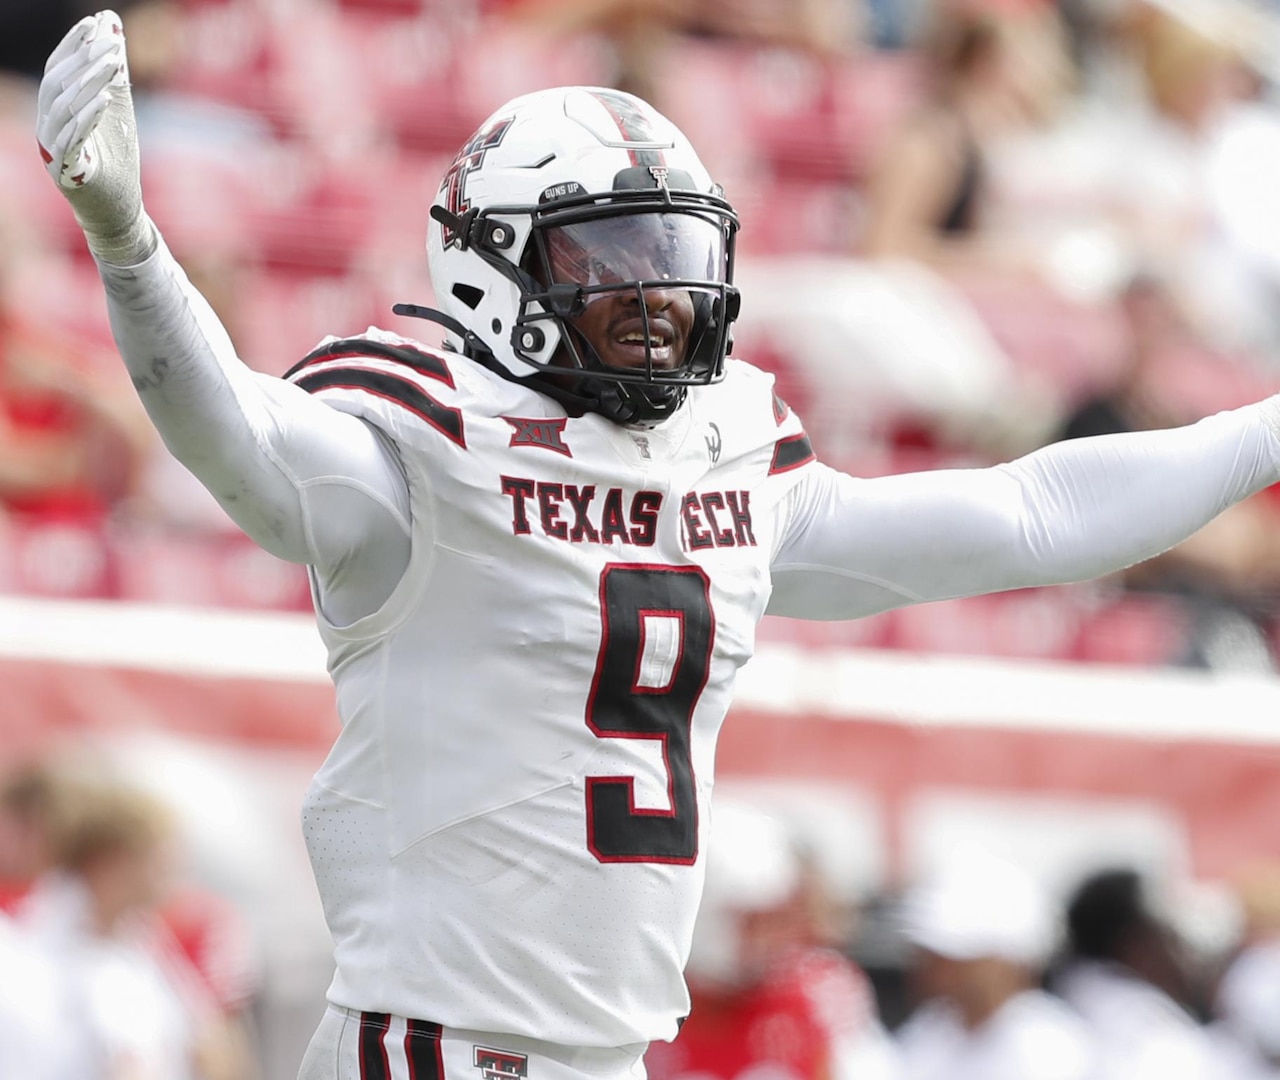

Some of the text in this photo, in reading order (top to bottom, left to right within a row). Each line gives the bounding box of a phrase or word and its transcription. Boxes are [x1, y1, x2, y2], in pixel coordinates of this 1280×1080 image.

[544, 183, 579, 199] GUNS UP
[500, 474, 758, 553] TEXAS ECH
[585, 562, 716, 866] 9
